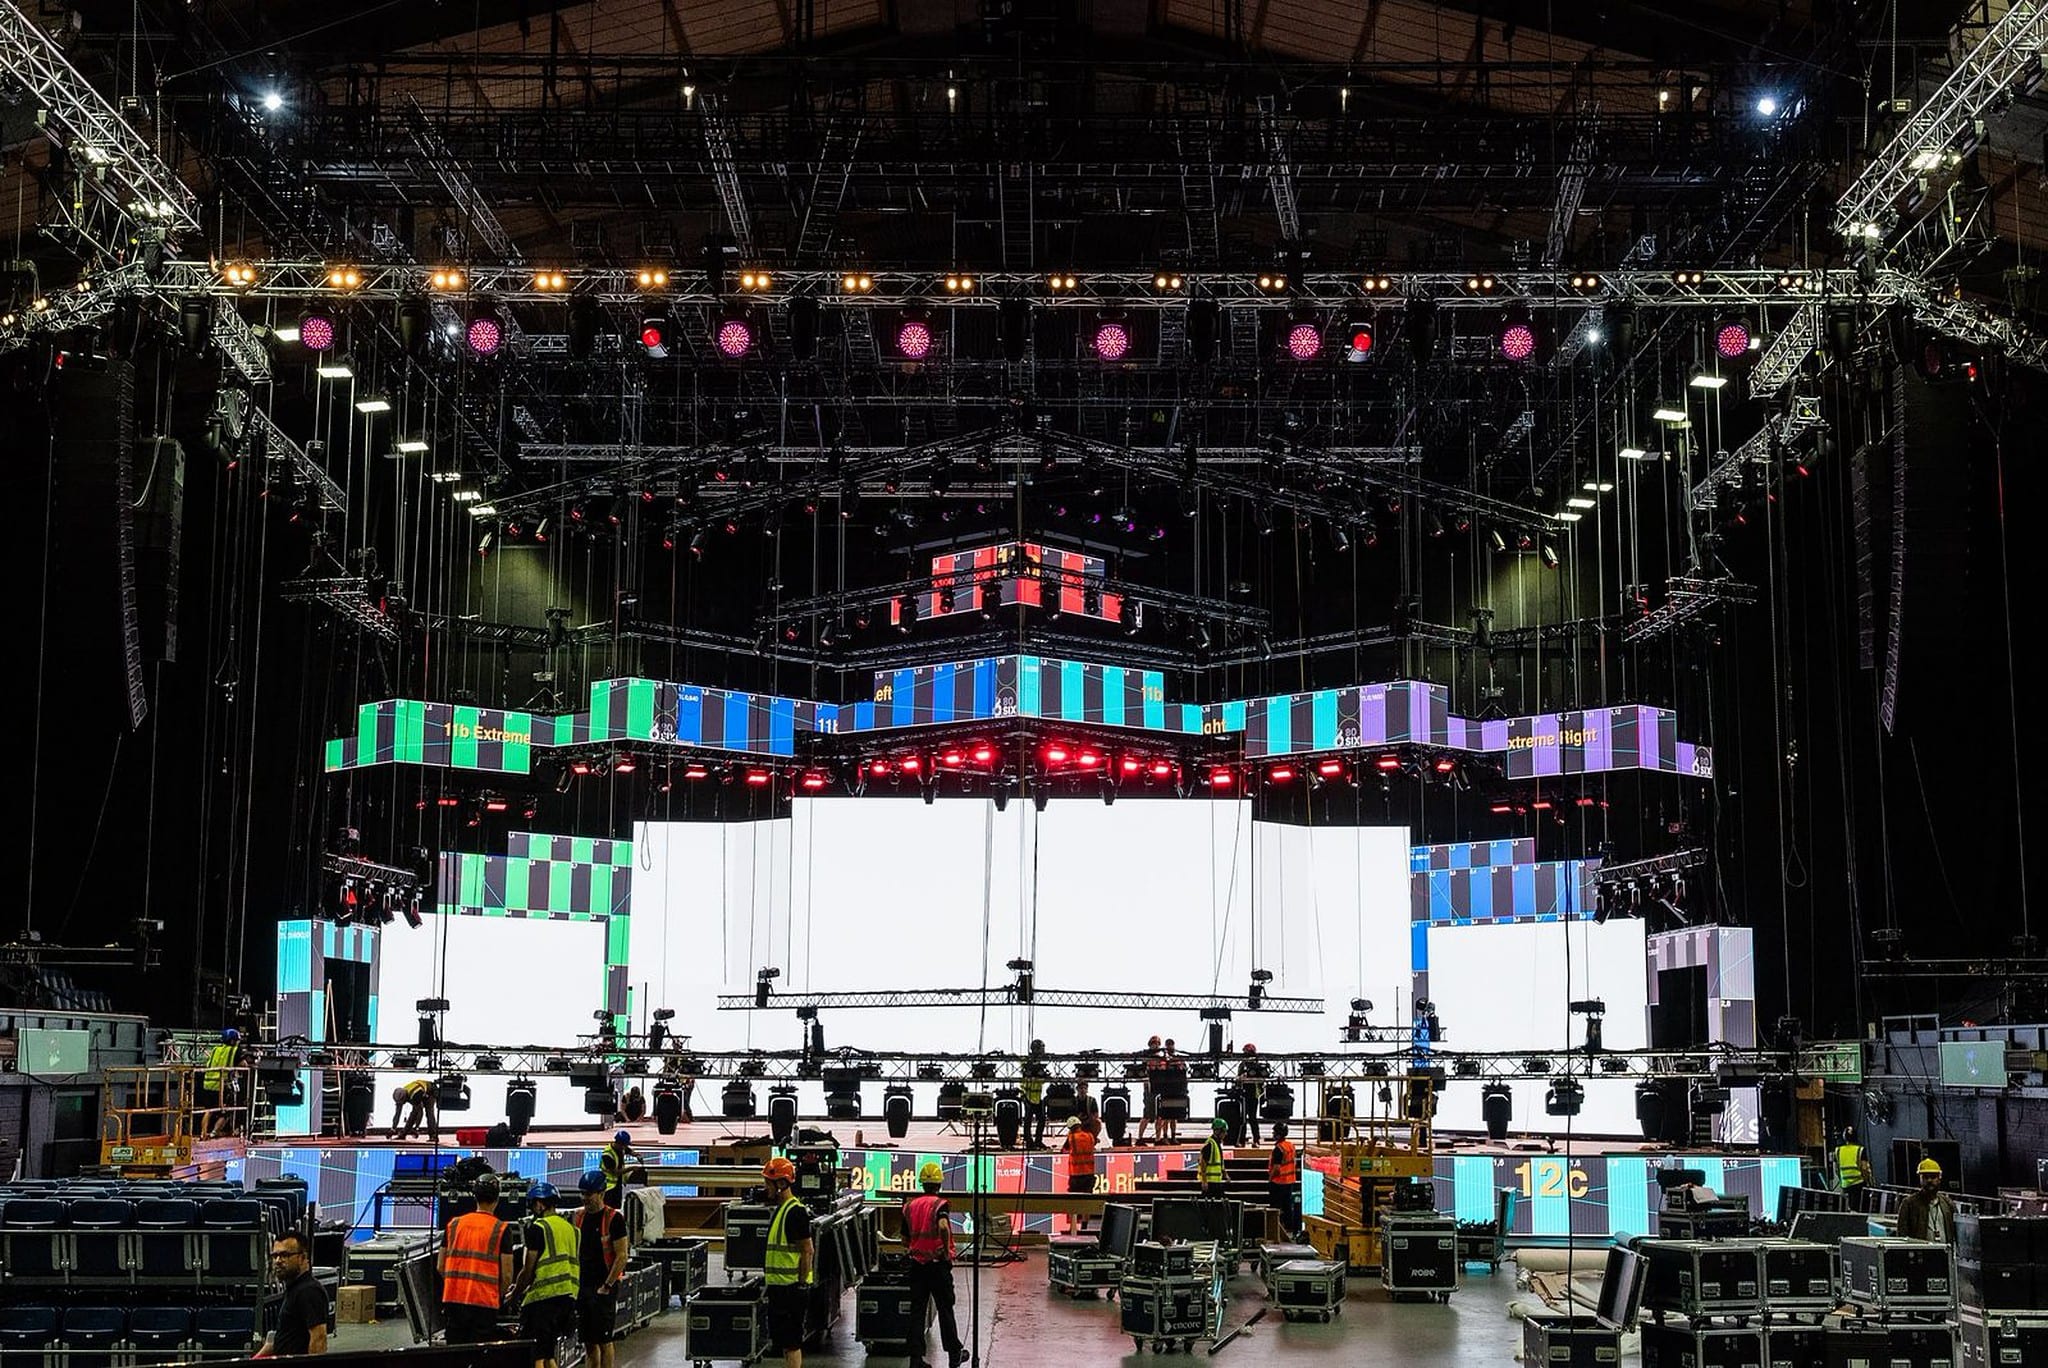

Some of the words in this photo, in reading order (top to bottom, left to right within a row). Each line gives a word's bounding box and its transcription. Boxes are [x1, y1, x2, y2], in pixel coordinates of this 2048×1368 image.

[874, 685, 892, 702] eft
[444, 722, 470, 738] 11b
[474, 726, 531, 745] Extreme
[1560, 728, 1597, 746] Right
[177, 1147, 188, 1157] 03
[851, 1167, 875, 1191] 2b
[880, 1168, 917, 1191] Left
[1092, 1173, 1110, 1194] 2b
[1514, 1161, 1589, 1198] 12c
[1172, 1321, 1201, 1330] encore
